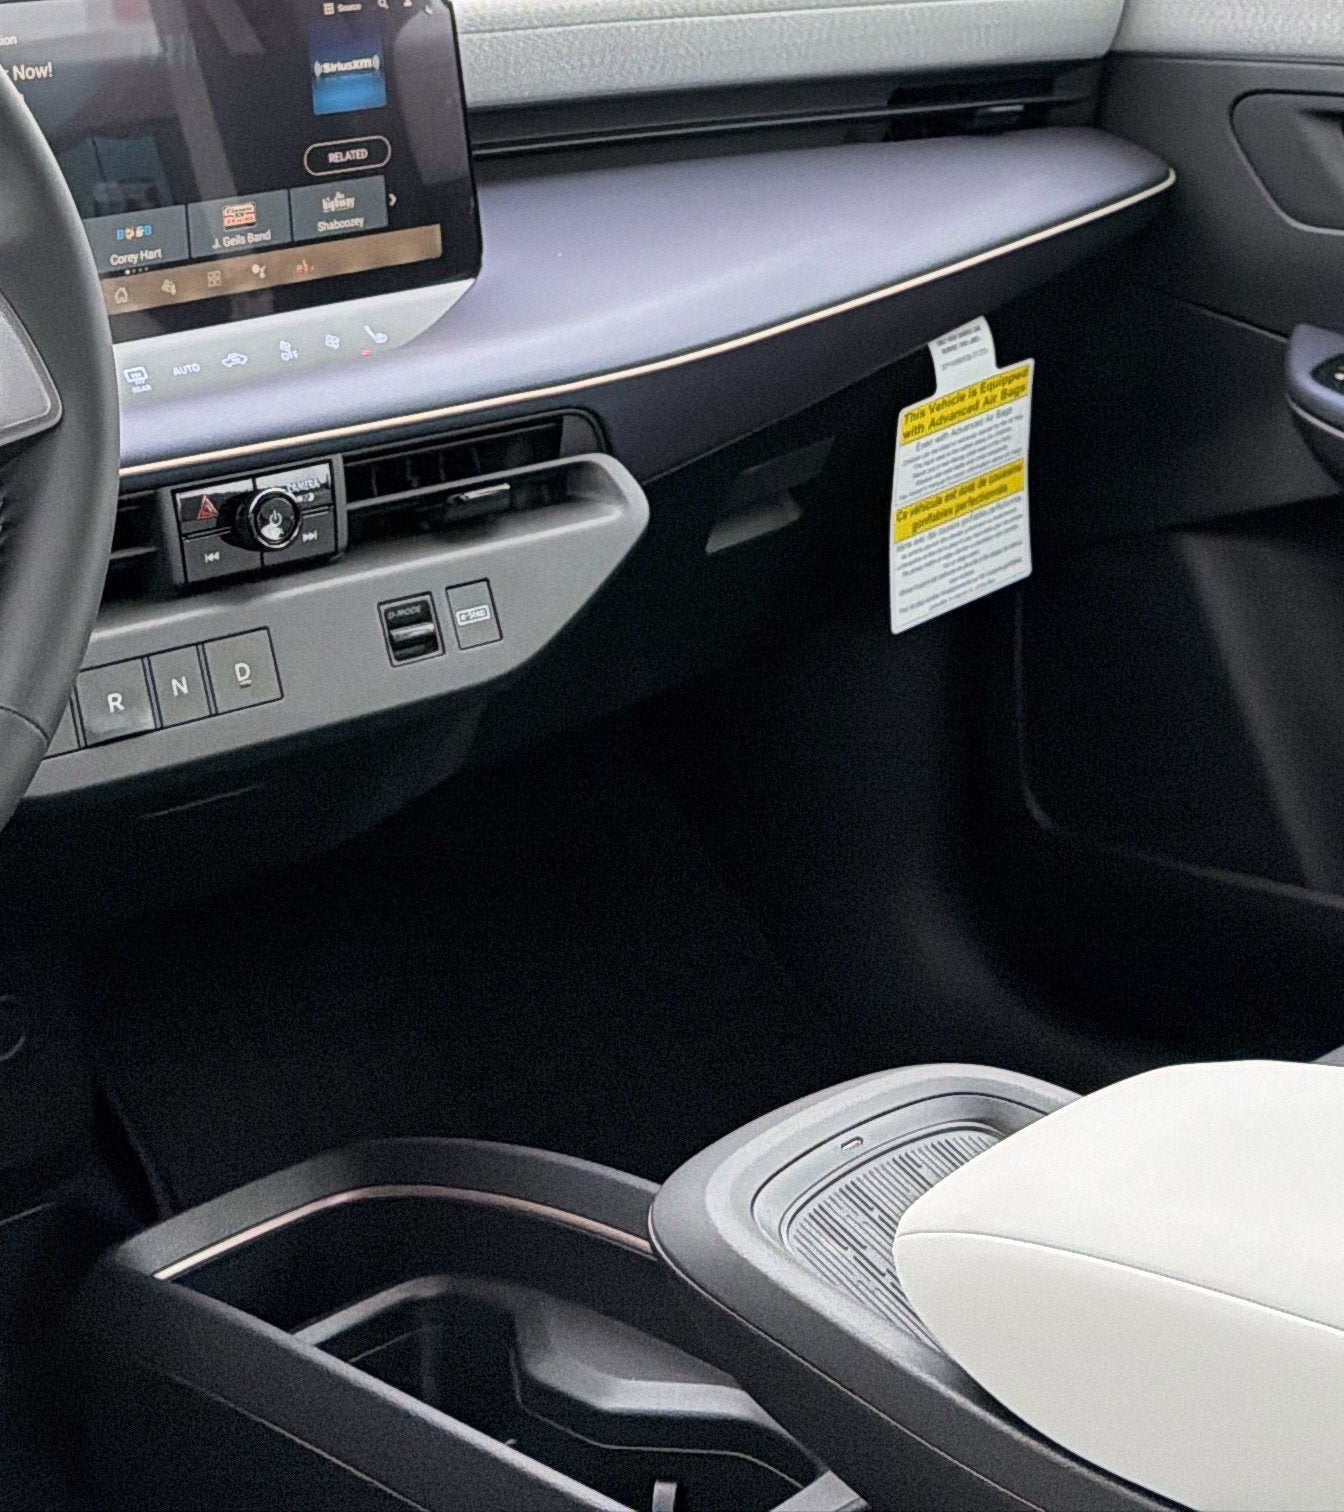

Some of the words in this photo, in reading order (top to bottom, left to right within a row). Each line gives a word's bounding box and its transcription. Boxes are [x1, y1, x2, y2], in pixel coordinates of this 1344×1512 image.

[12, 61, 54, 81] Now!
[327, 148, 369, 164] RELATED
[140, 248, 163, 262] Hart
[173, 362, 201, 377] AUTO
[904, 408, 926, 424] This
[928, 391, 967, 414] Vehicle
[902, 423, 925, 439] with
[928, 400, 980, 429] Advanced
[234, 662, 252, 683] D
[171, 675, 189, 697] N
[107, 692, 125, 714] R
